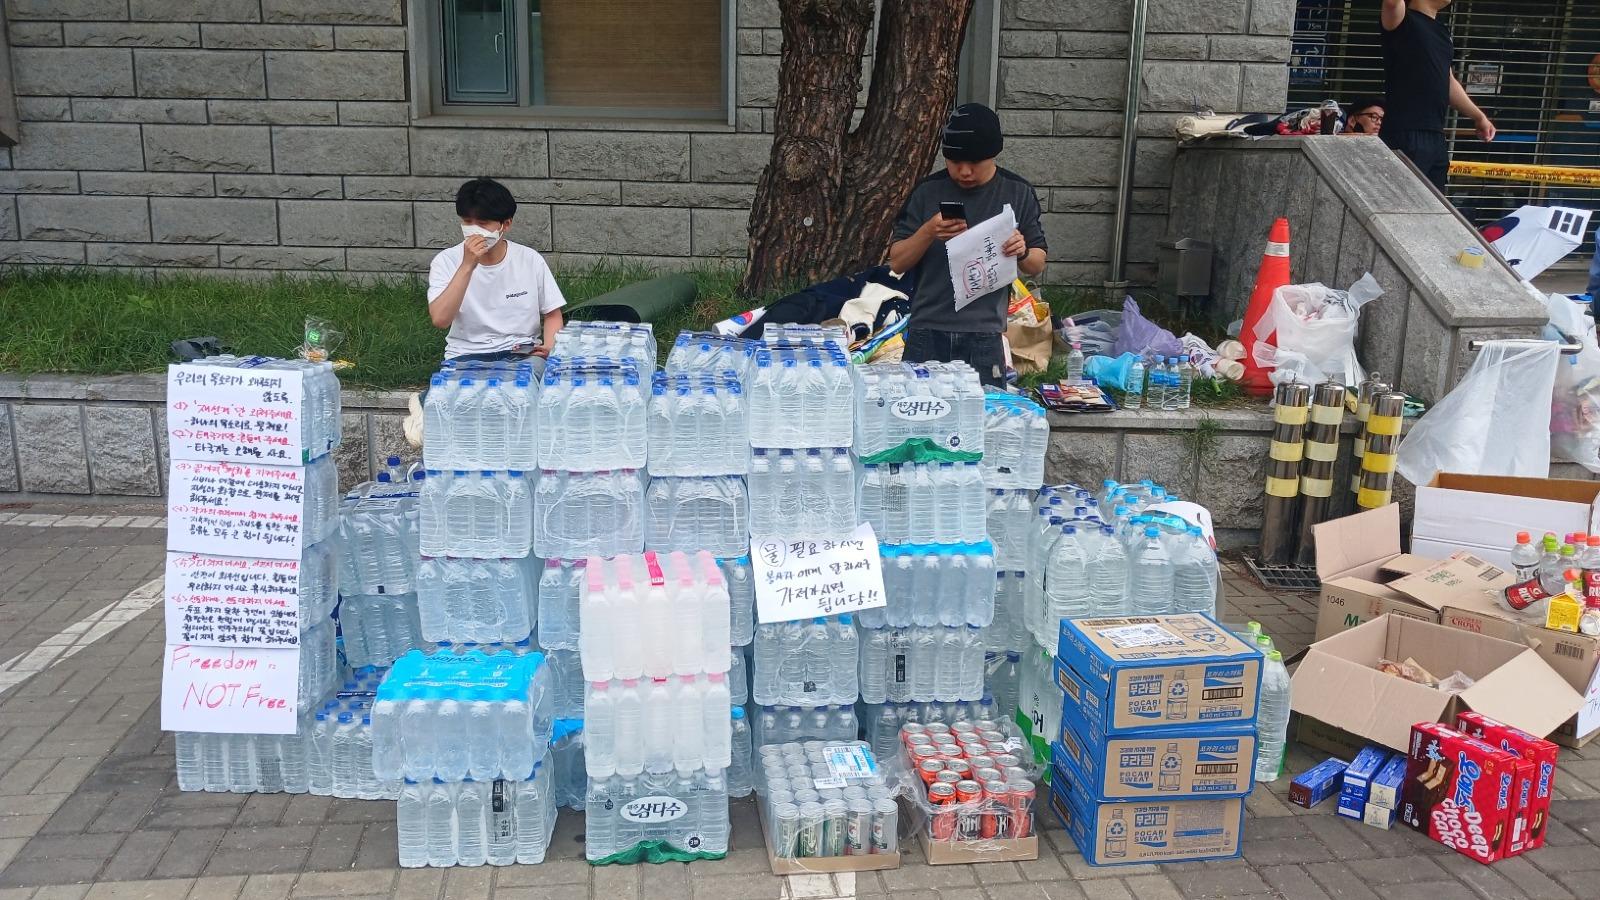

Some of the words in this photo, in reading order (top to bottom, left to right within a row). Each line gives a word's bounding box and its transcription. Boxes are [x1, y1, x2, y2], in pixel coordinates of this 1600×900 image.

[175, 371, 206, 385] 우리의
[210, 372, 244, 386] 목소리가
[900, 401, 945, 416] 삼다수
[213, 528, 229, 539] 모두
[764, 543, 778, 563] 물
[1326, 595, 1345, 607] 1046
[171, 645, 257, 670] Freedom
[183, 682, 241, 710] NOT
[1128, 699, 1161, 707] POCARI
[629, 802, 681, 819] 삼다수
[1463, 811, 1489, 858] Deep
